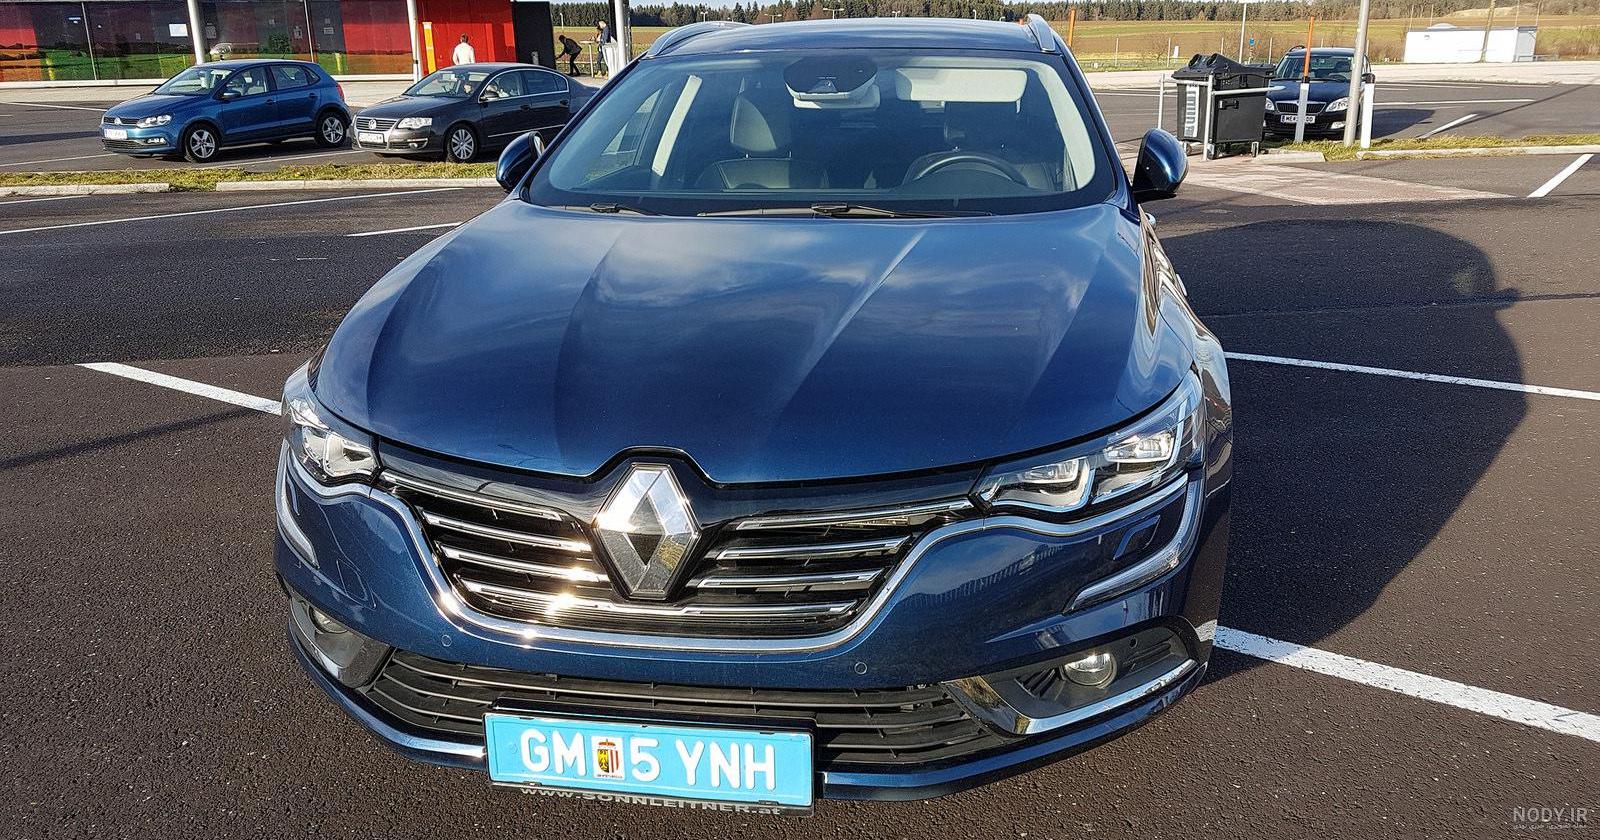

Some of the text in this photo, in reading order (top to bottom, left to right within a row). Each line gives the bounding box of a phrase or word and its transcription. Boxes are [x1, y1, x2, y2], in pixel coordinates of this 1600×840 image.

[520, 728, 777, 791] GM 5 YNH
